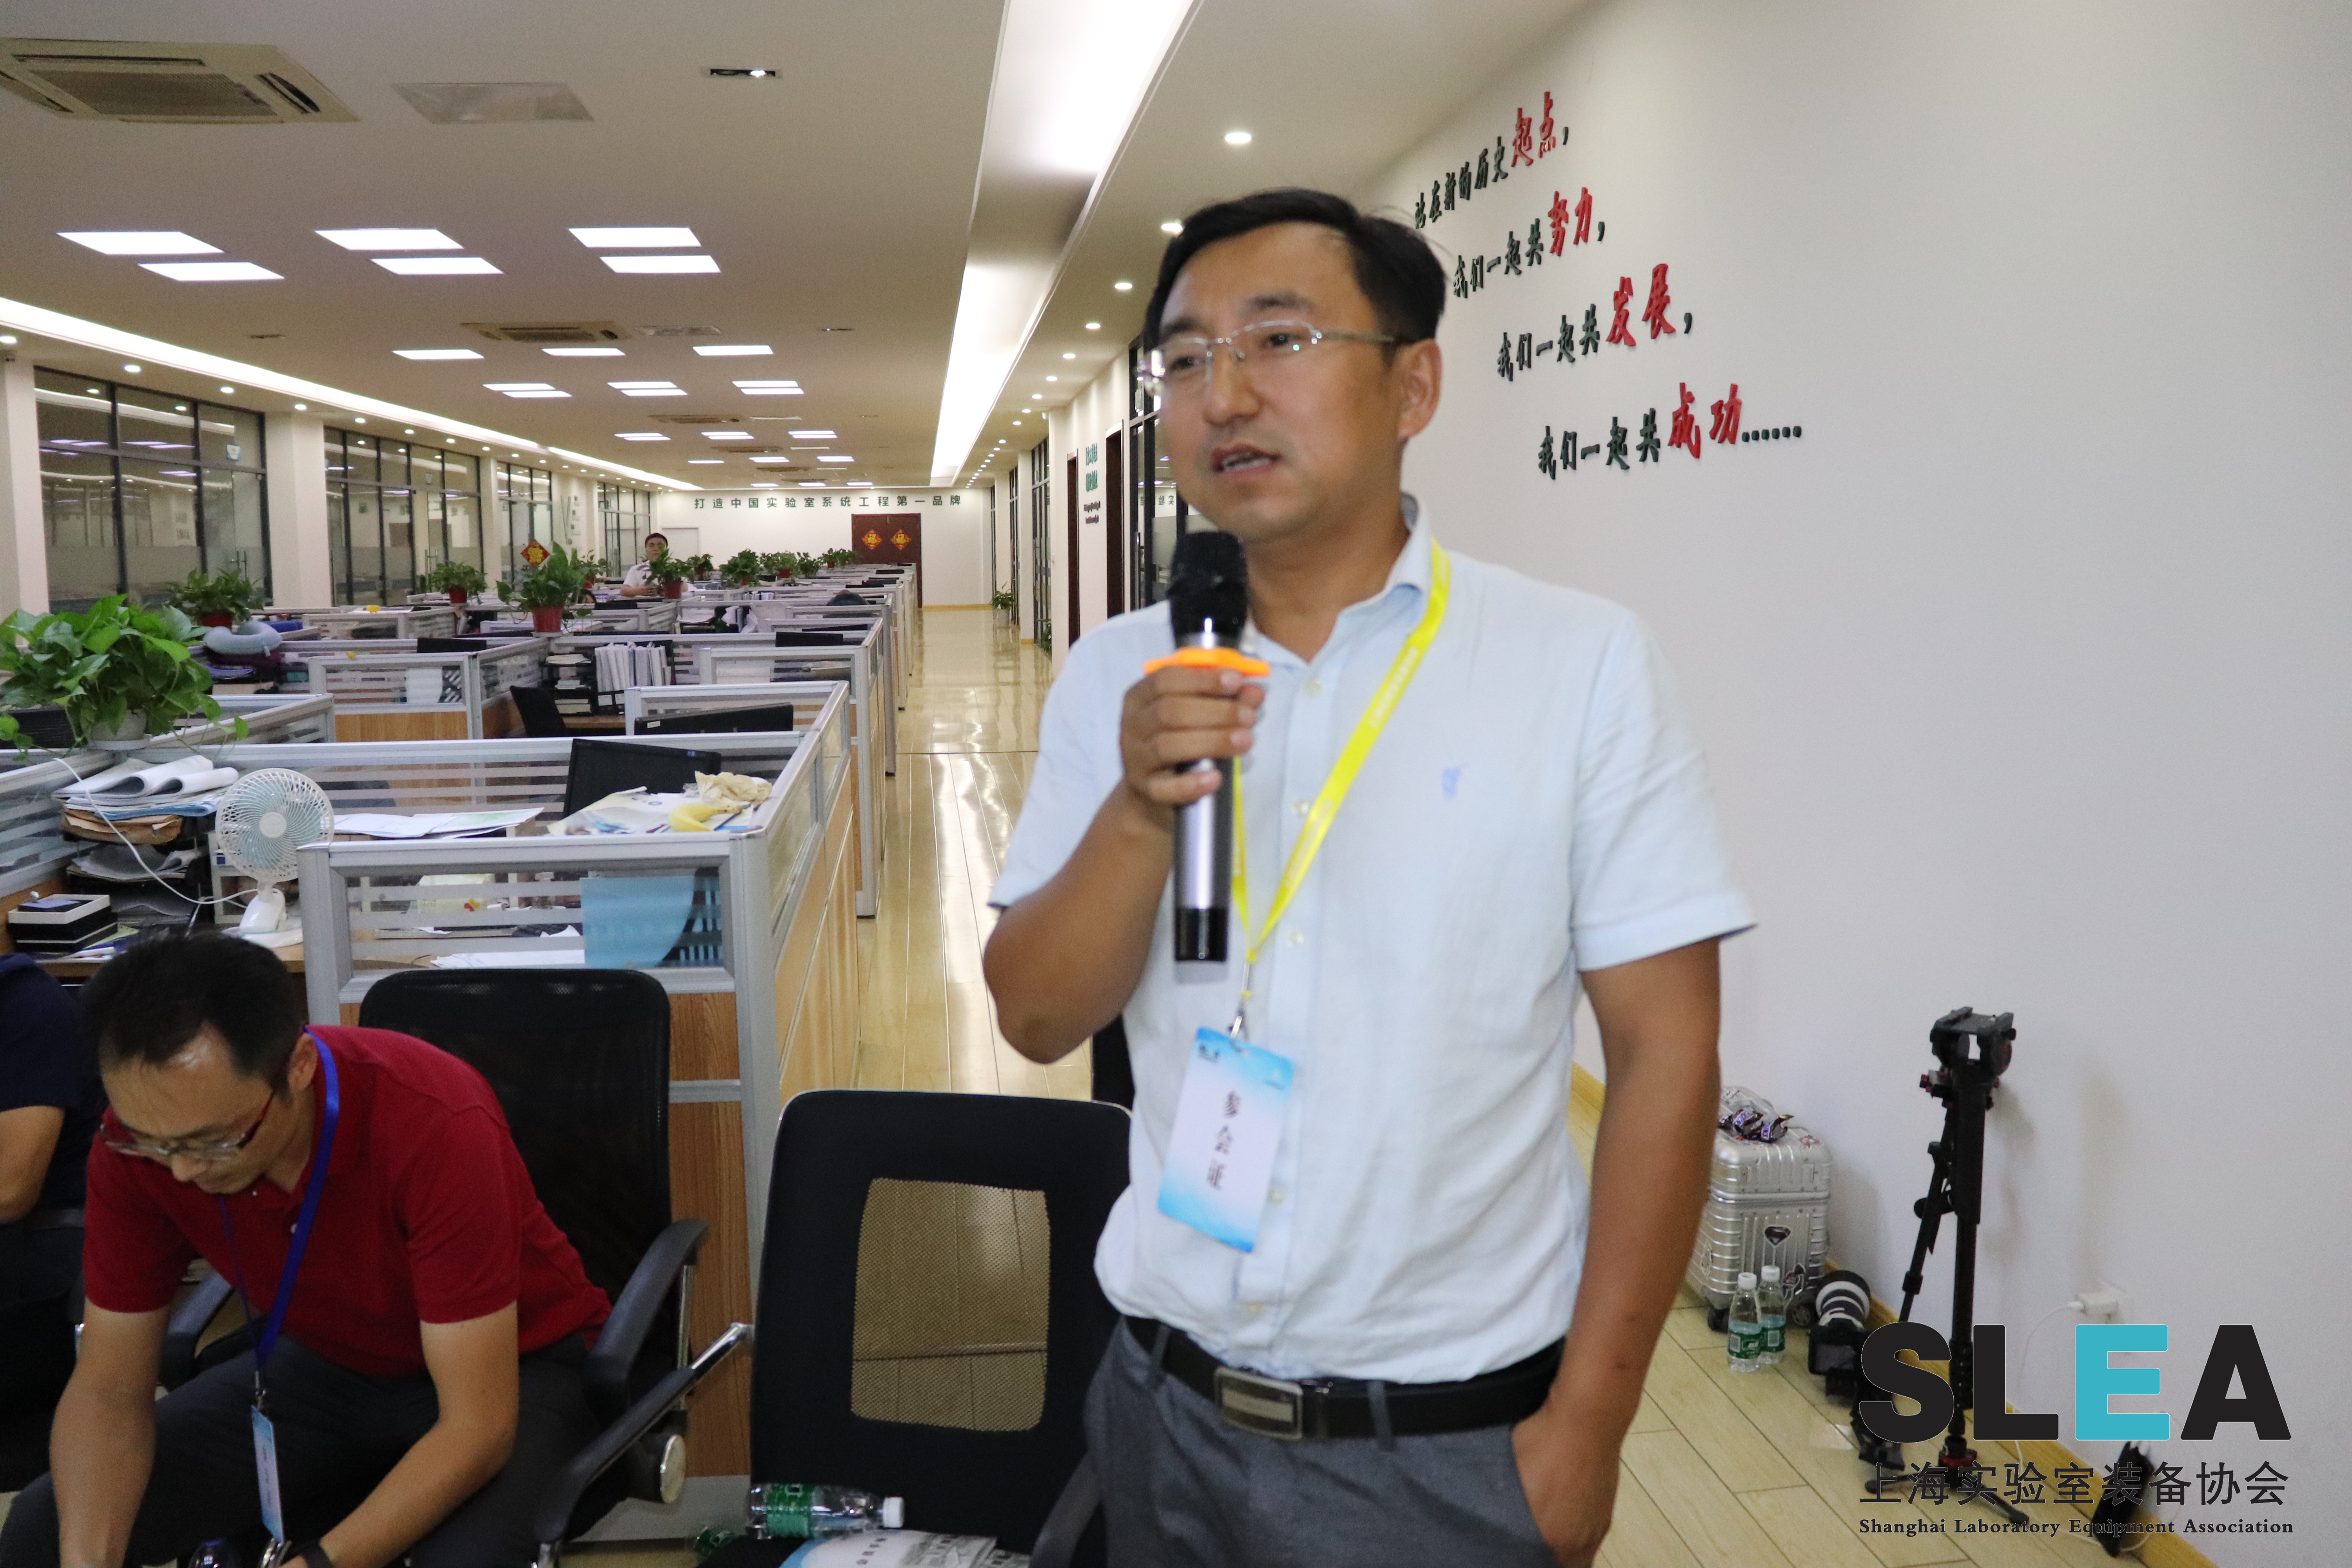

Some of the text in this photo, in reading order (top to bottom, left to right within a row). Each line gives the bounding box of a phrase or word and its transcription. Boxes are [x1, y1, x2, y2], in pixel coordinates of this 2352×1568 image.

[1453, 187, 1605, 298] 我们一起共努力，
[1497, 263, 1692, 382] 我们一起共发展，
[694, 495, 962, 509] 打造中国实验室系统工程第一品牌
